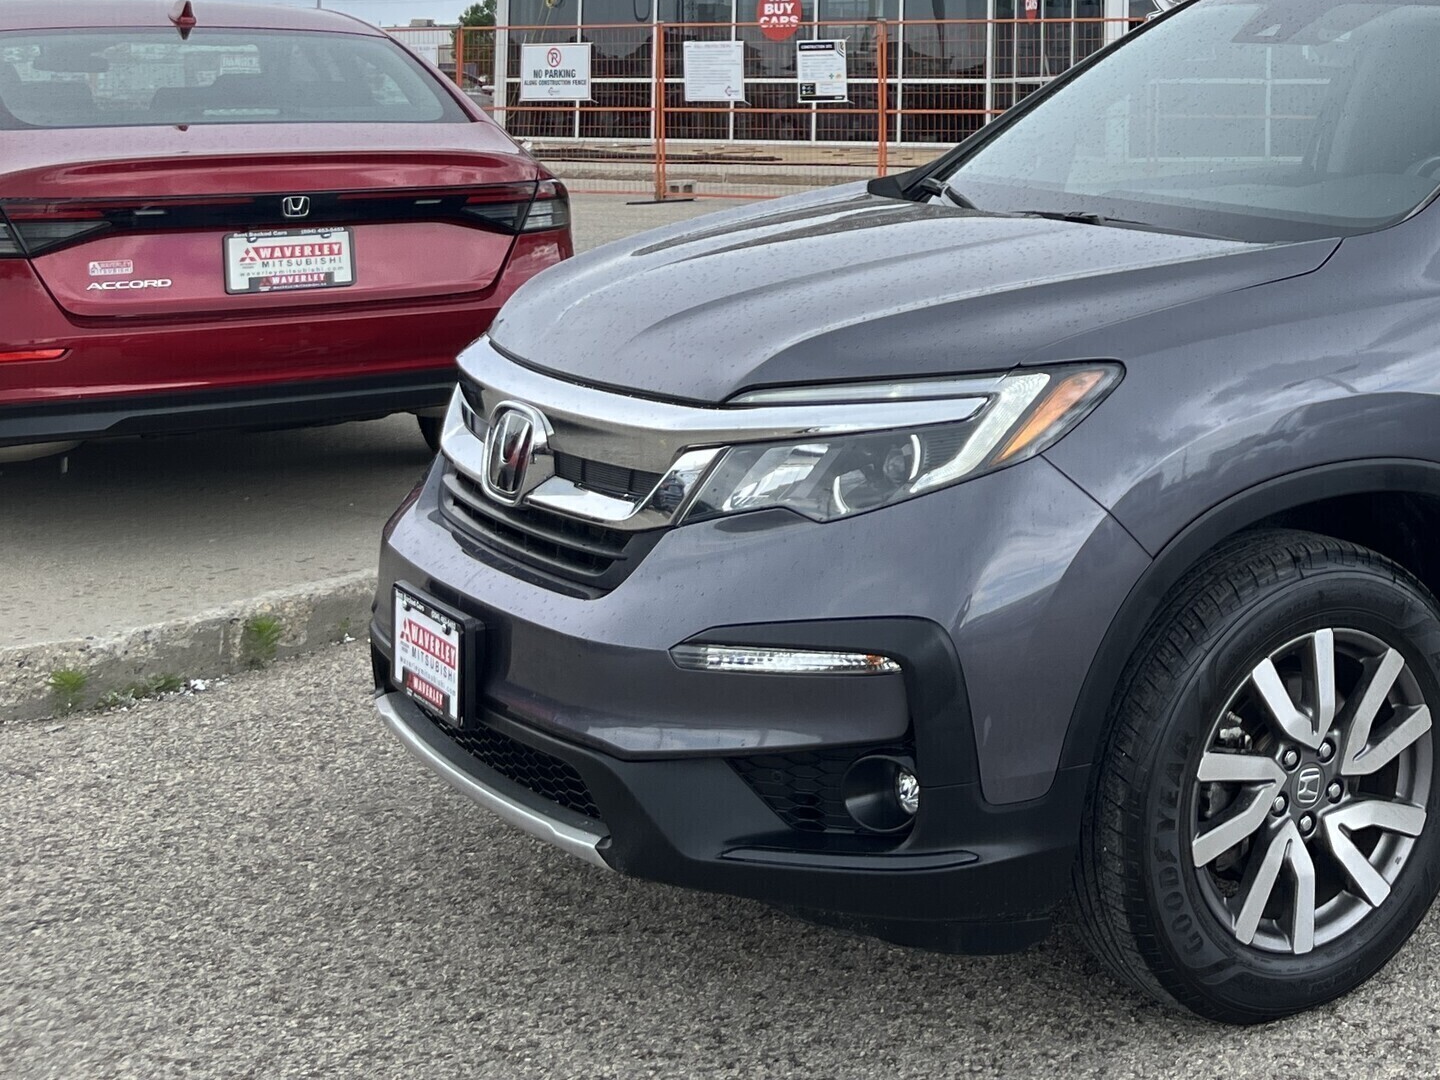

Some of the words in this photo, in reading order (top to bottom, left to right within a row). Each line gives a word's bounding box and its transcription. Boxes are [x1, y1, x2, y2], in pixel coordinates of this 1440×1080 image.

[764, 3, 795, 15] BUY
[760, 15, 799, 28] CARS
[533, 69, 543, 78] NO
[544, 68, 577, 78] PARKING
[259, 243, 341, 258] WAVERLEY
[261, 257, 342, 268] MITSUBISHI
[86, 279, 172, 291] ACCORD
[271, 273, 326, 285] WAVERLEY
[410, 621, 456, 668] WAVERLEY
[411, 645, 456, 684] MITSUBISHI
[413, 675, 444, 707] WAVERLEY
